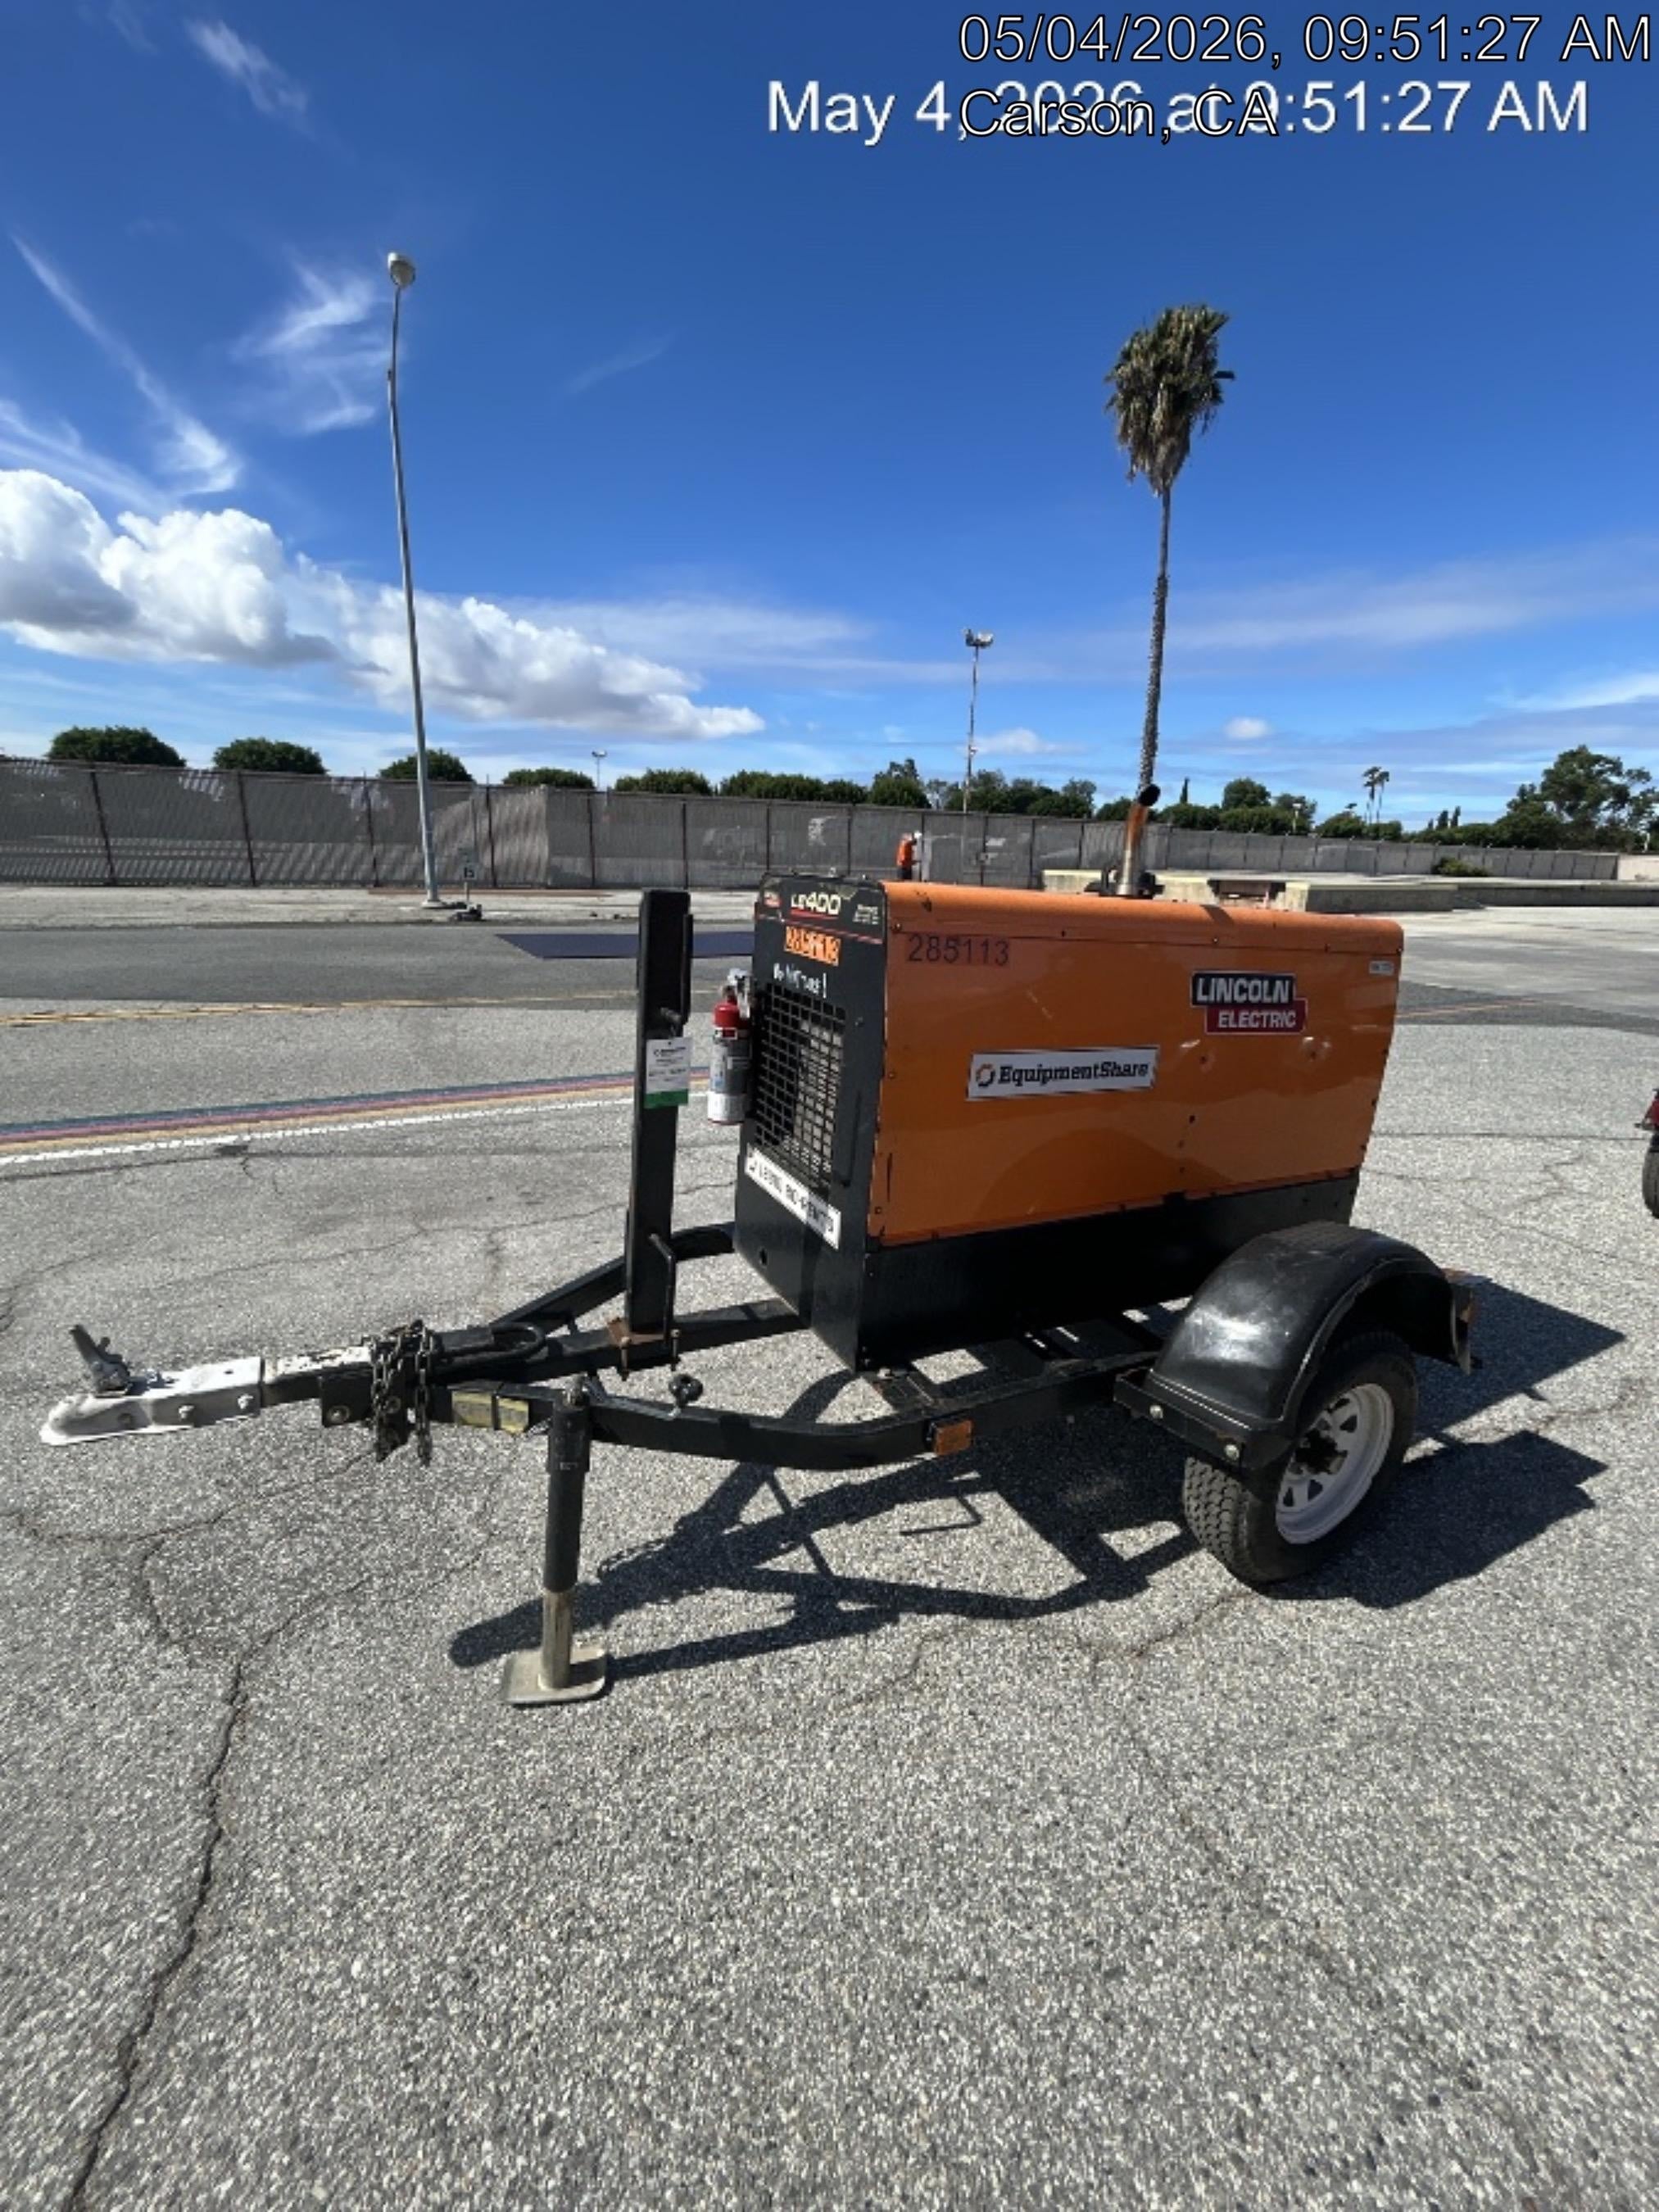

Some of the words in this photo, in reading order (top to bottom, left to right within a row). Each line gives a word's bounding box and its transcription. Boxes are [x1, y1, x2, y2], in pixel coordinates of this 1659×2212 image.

[908, 932, 1009, 967] 285113
[1196, 976, 1291, 1004] LINCOLN
[1217, 1009, 1298, 1029] ELECTRIC
[997, 1061, 1152, 1086] EquipmentShare
